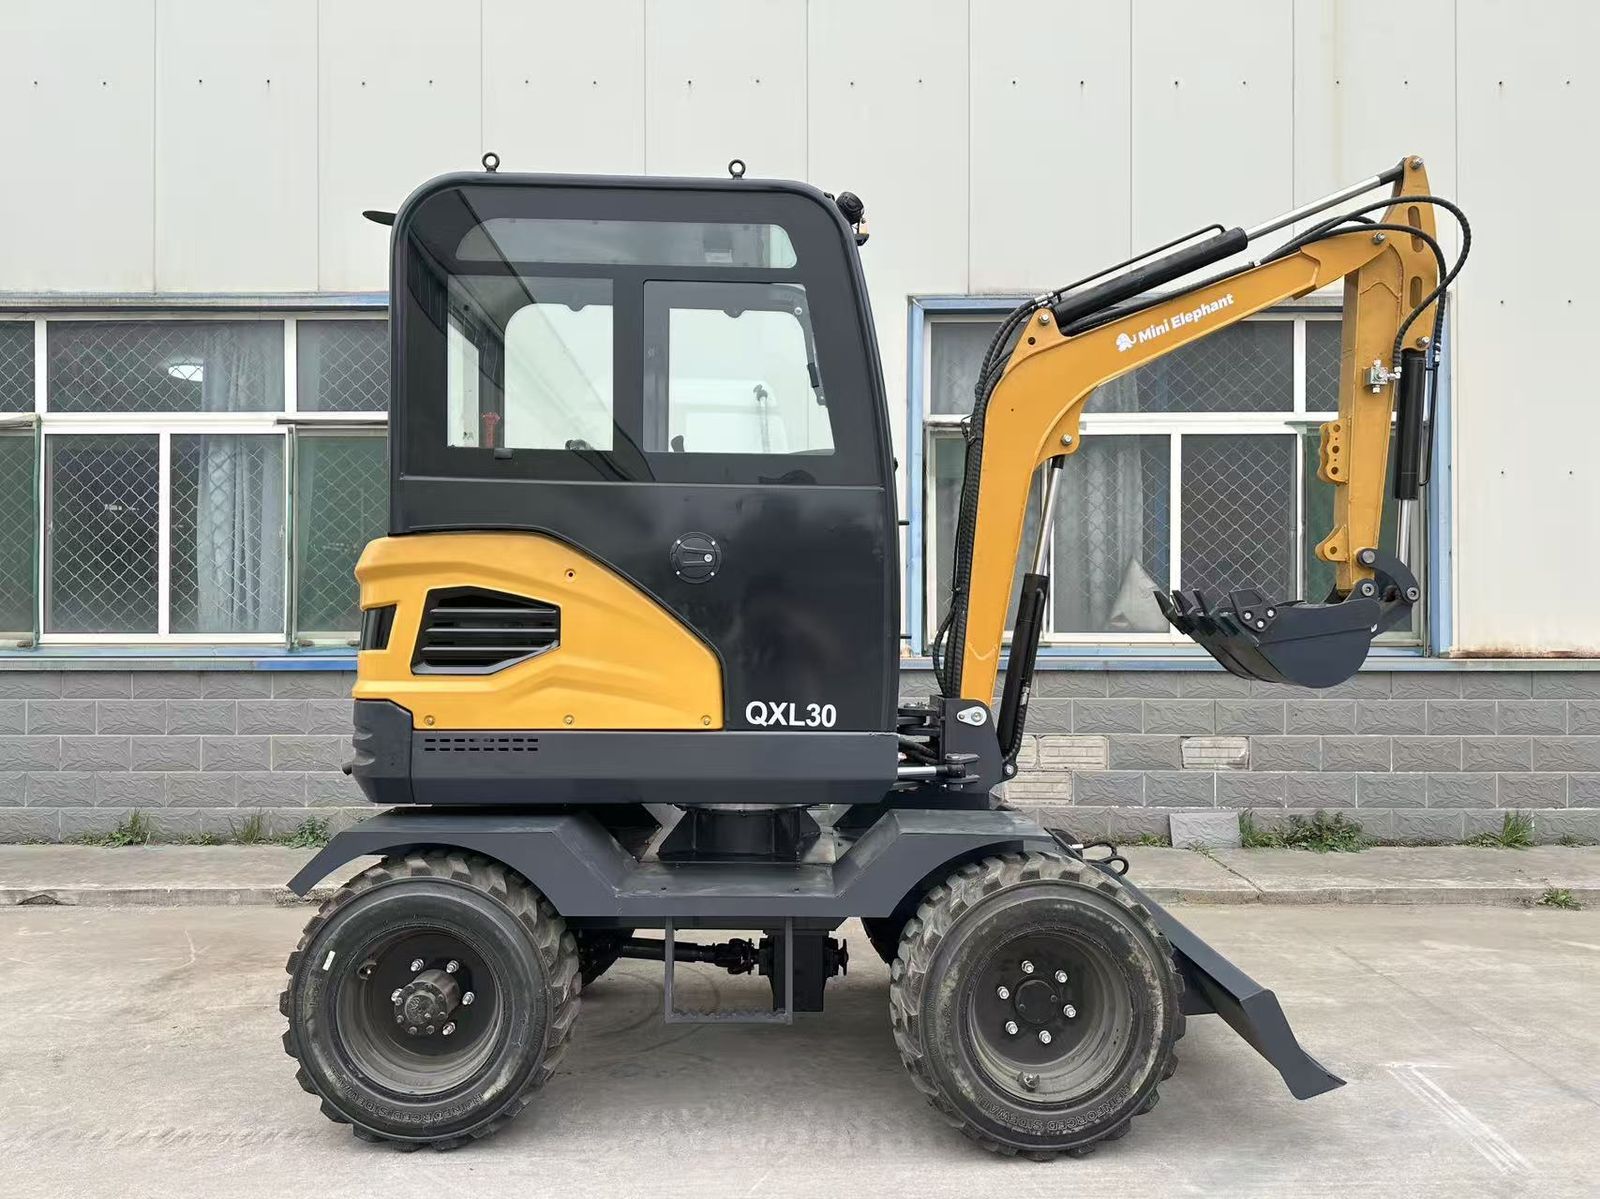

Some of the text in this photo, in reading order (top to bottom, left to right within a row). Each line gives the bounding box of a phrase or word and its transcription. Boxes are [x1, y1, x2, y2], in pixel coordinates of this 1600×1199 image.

[1138, 293, 1235, 343] Mini Elephant
[745, 700, 837, 728] QXL30
